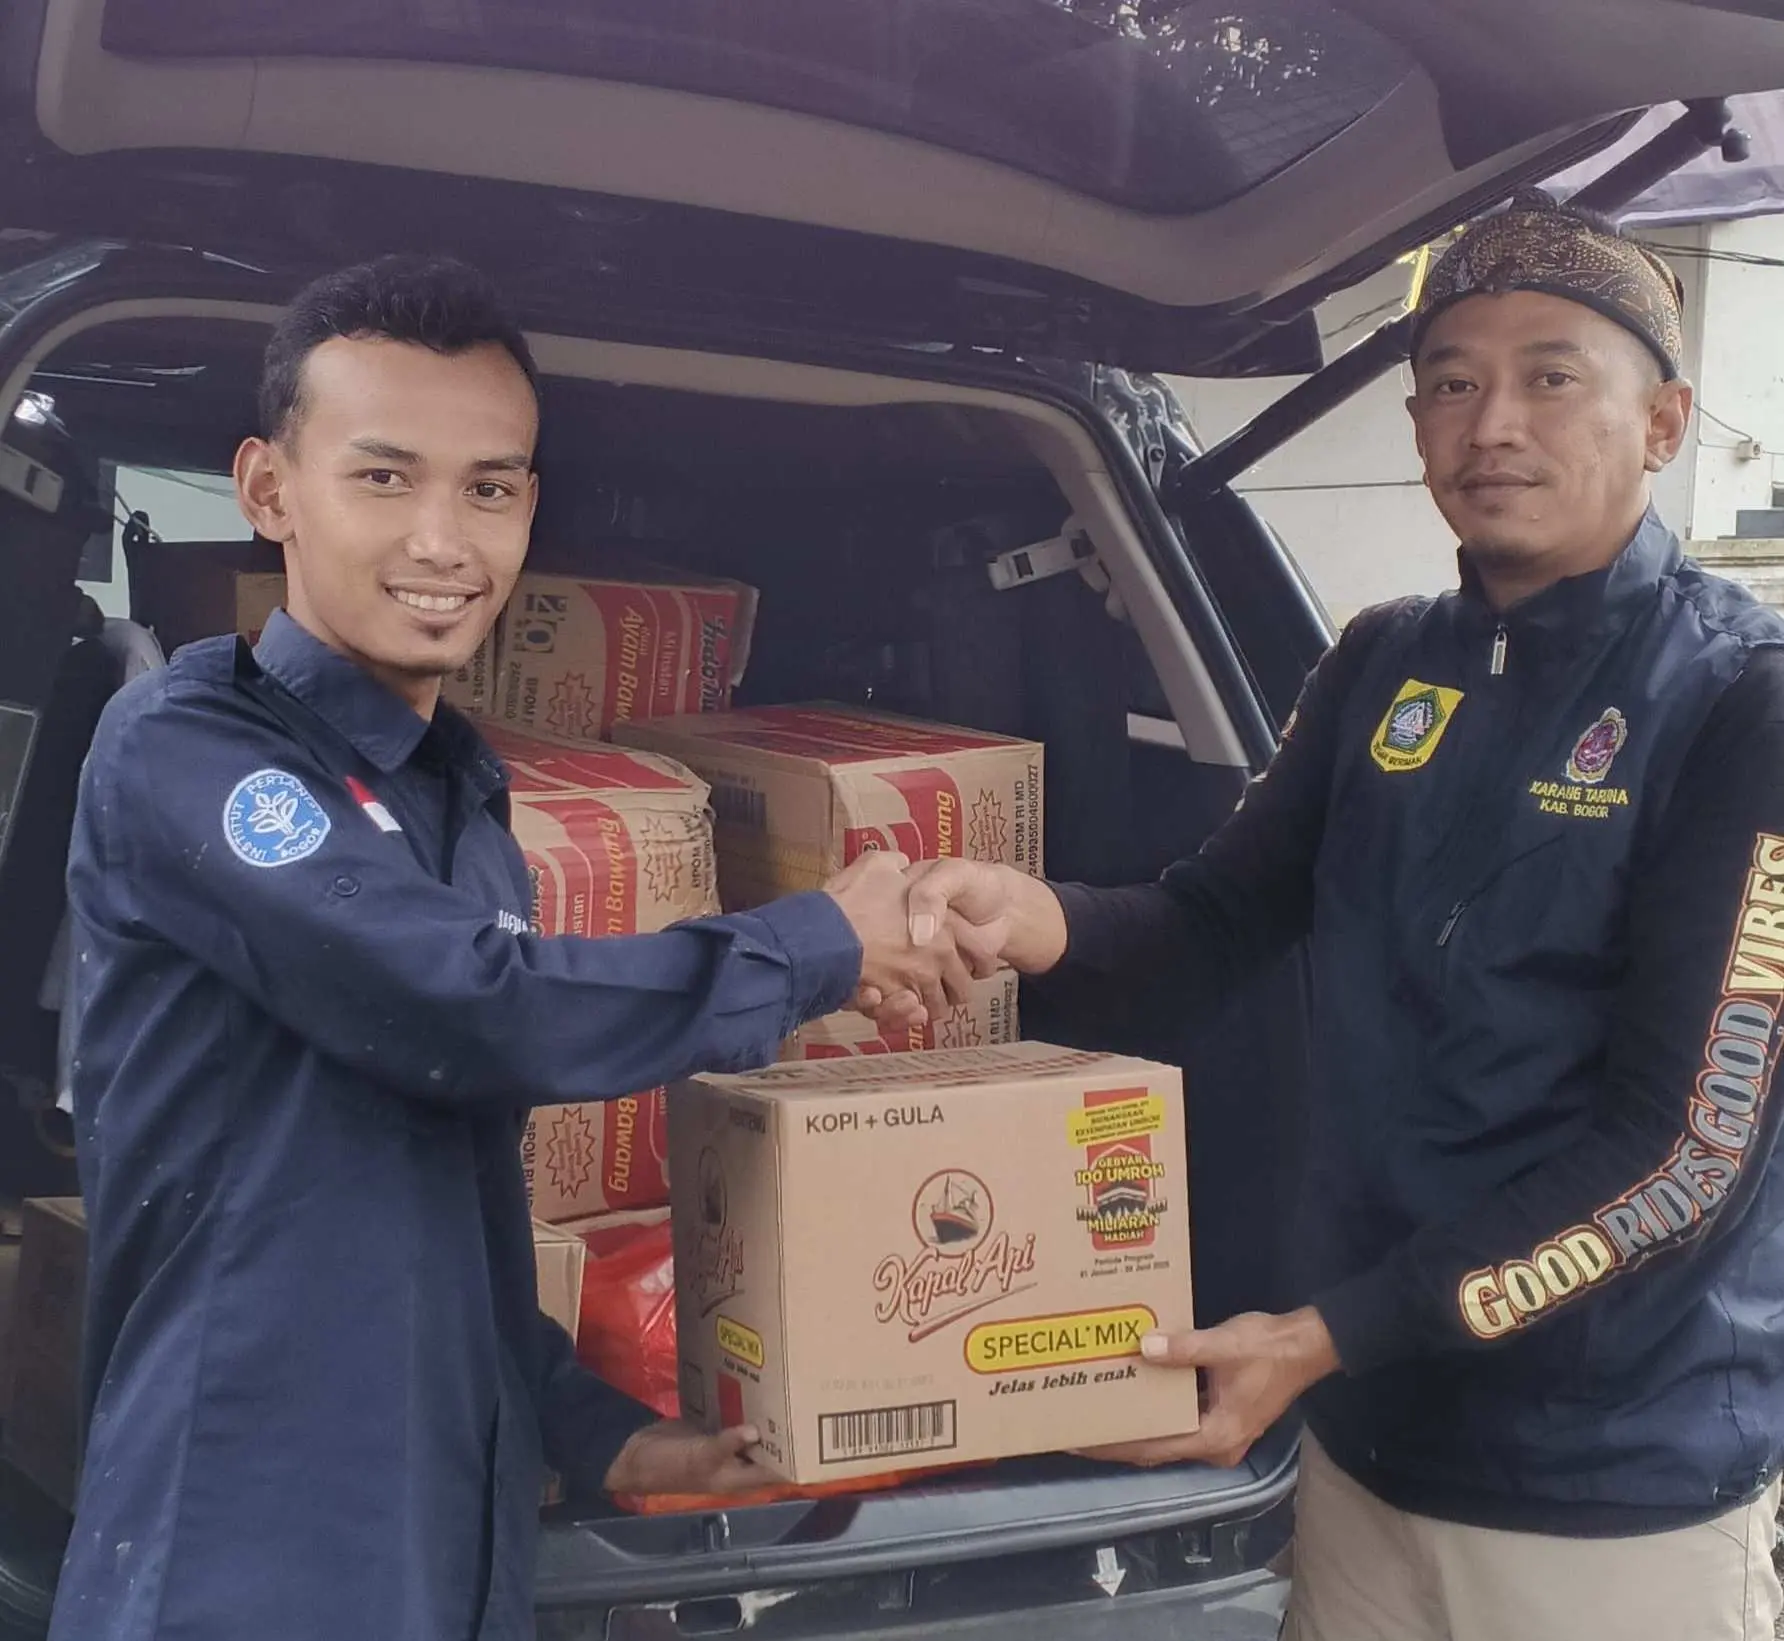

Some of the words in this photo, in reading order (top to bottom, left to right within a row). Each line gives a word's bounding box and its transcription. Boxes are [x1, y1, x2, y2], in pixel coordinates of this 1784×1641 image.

[620, 604, 645, 669] Ayam
[613, 672, 638, 722] Baw
[1014, 780, 1025, 801] MD
[936, 790, 956, 858] wang
[1014, 803, 1025, 818] RI
[1574, 804, 1609, 819] BOGOR
[1014, 821, 1025, 862] BPOM
[805, 1111, 859, 1134] KOPI
[883, 1104, 945, 1128] GULA
[608, 1097, 638, 1192] Bawang
[1076, 1170, 1104, 1185] 100
[1107, 1163, 1164, 1182] UMROH
[1460, 1223, 1616, 1338] GOOD
[1594, 1134, 1741, 1260] RIDES
[1690, 998, 1775, 1154] GOOD
[1087, 1213, 1160, 1233] MILIARAN
[873, 1246, 977, 1327] Kapal
[971, 1231, 1037, 1293] Api
[1094, 1319, 1141, 1346] MIX
[988, 1378, 1035, 1396] Jelas
[1041, 1371, 1088, 1389] lebih
[1093, 1364, 1138, 1383] enak
